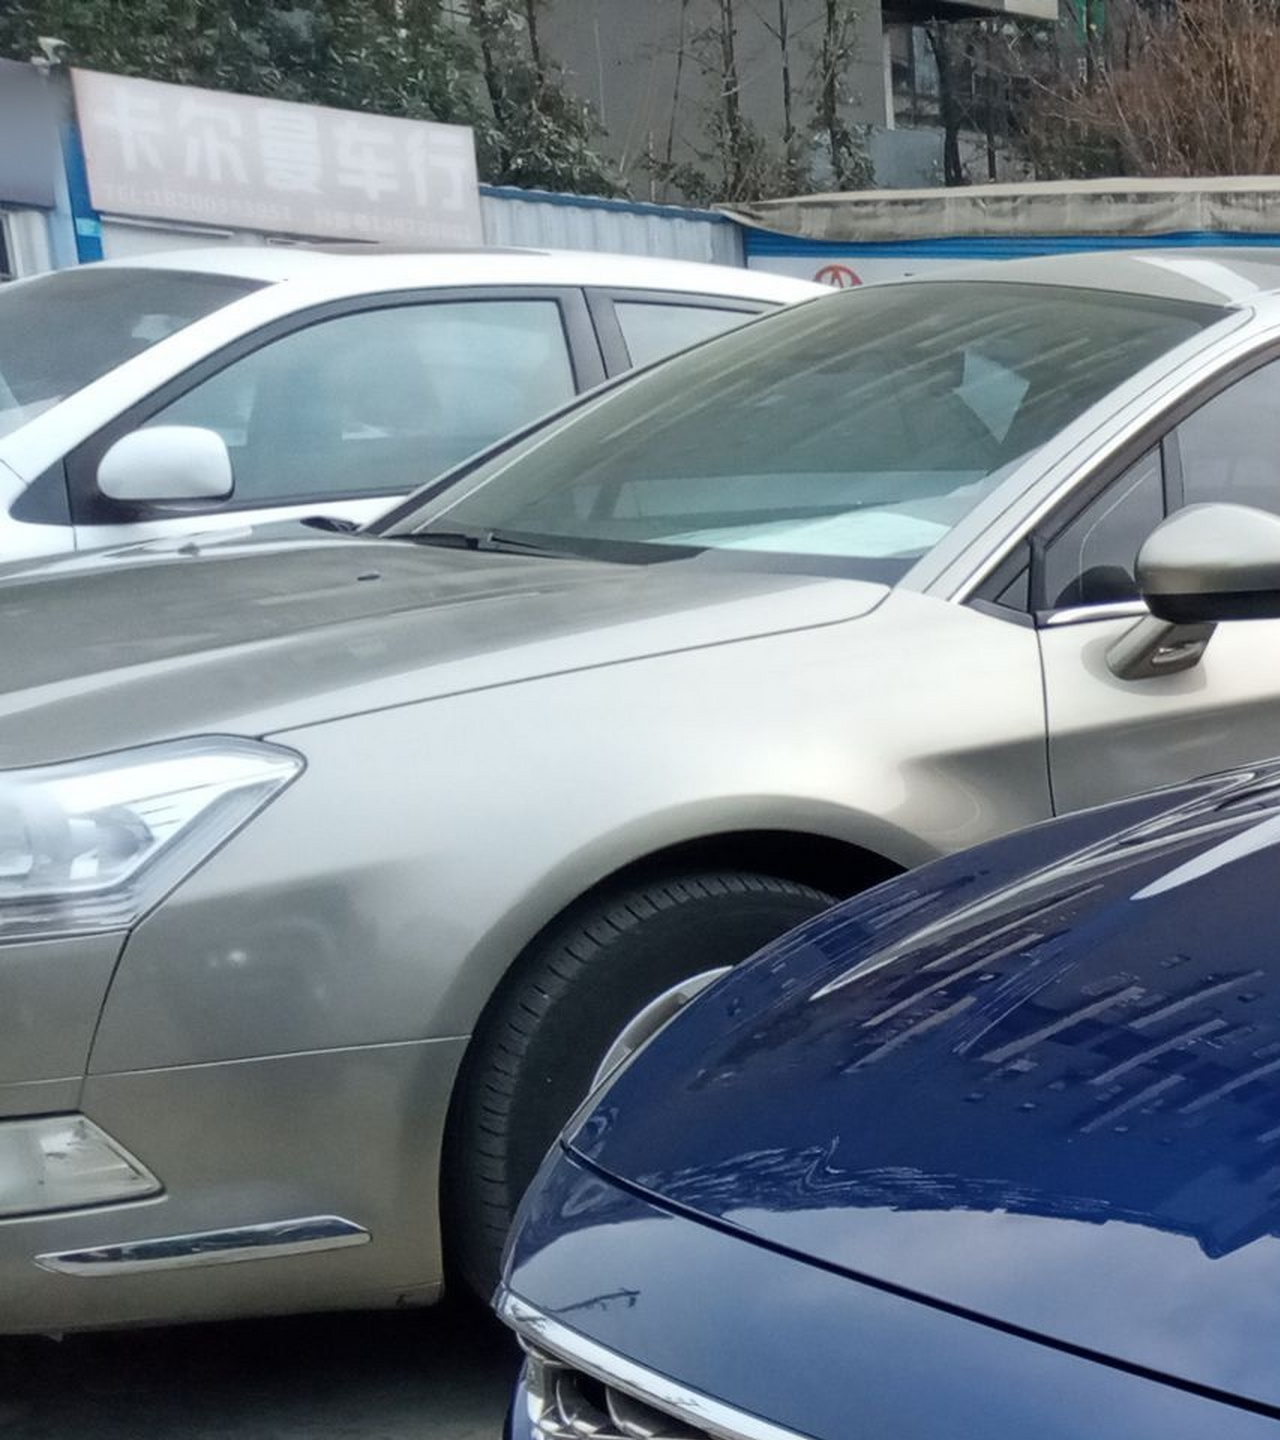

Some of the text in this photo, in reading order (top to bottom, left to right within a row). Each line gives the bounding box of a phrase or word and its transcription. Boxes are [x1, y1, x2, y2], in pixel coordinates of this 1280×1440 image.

[94, 85, 466, 211] 卡尔曼车行
